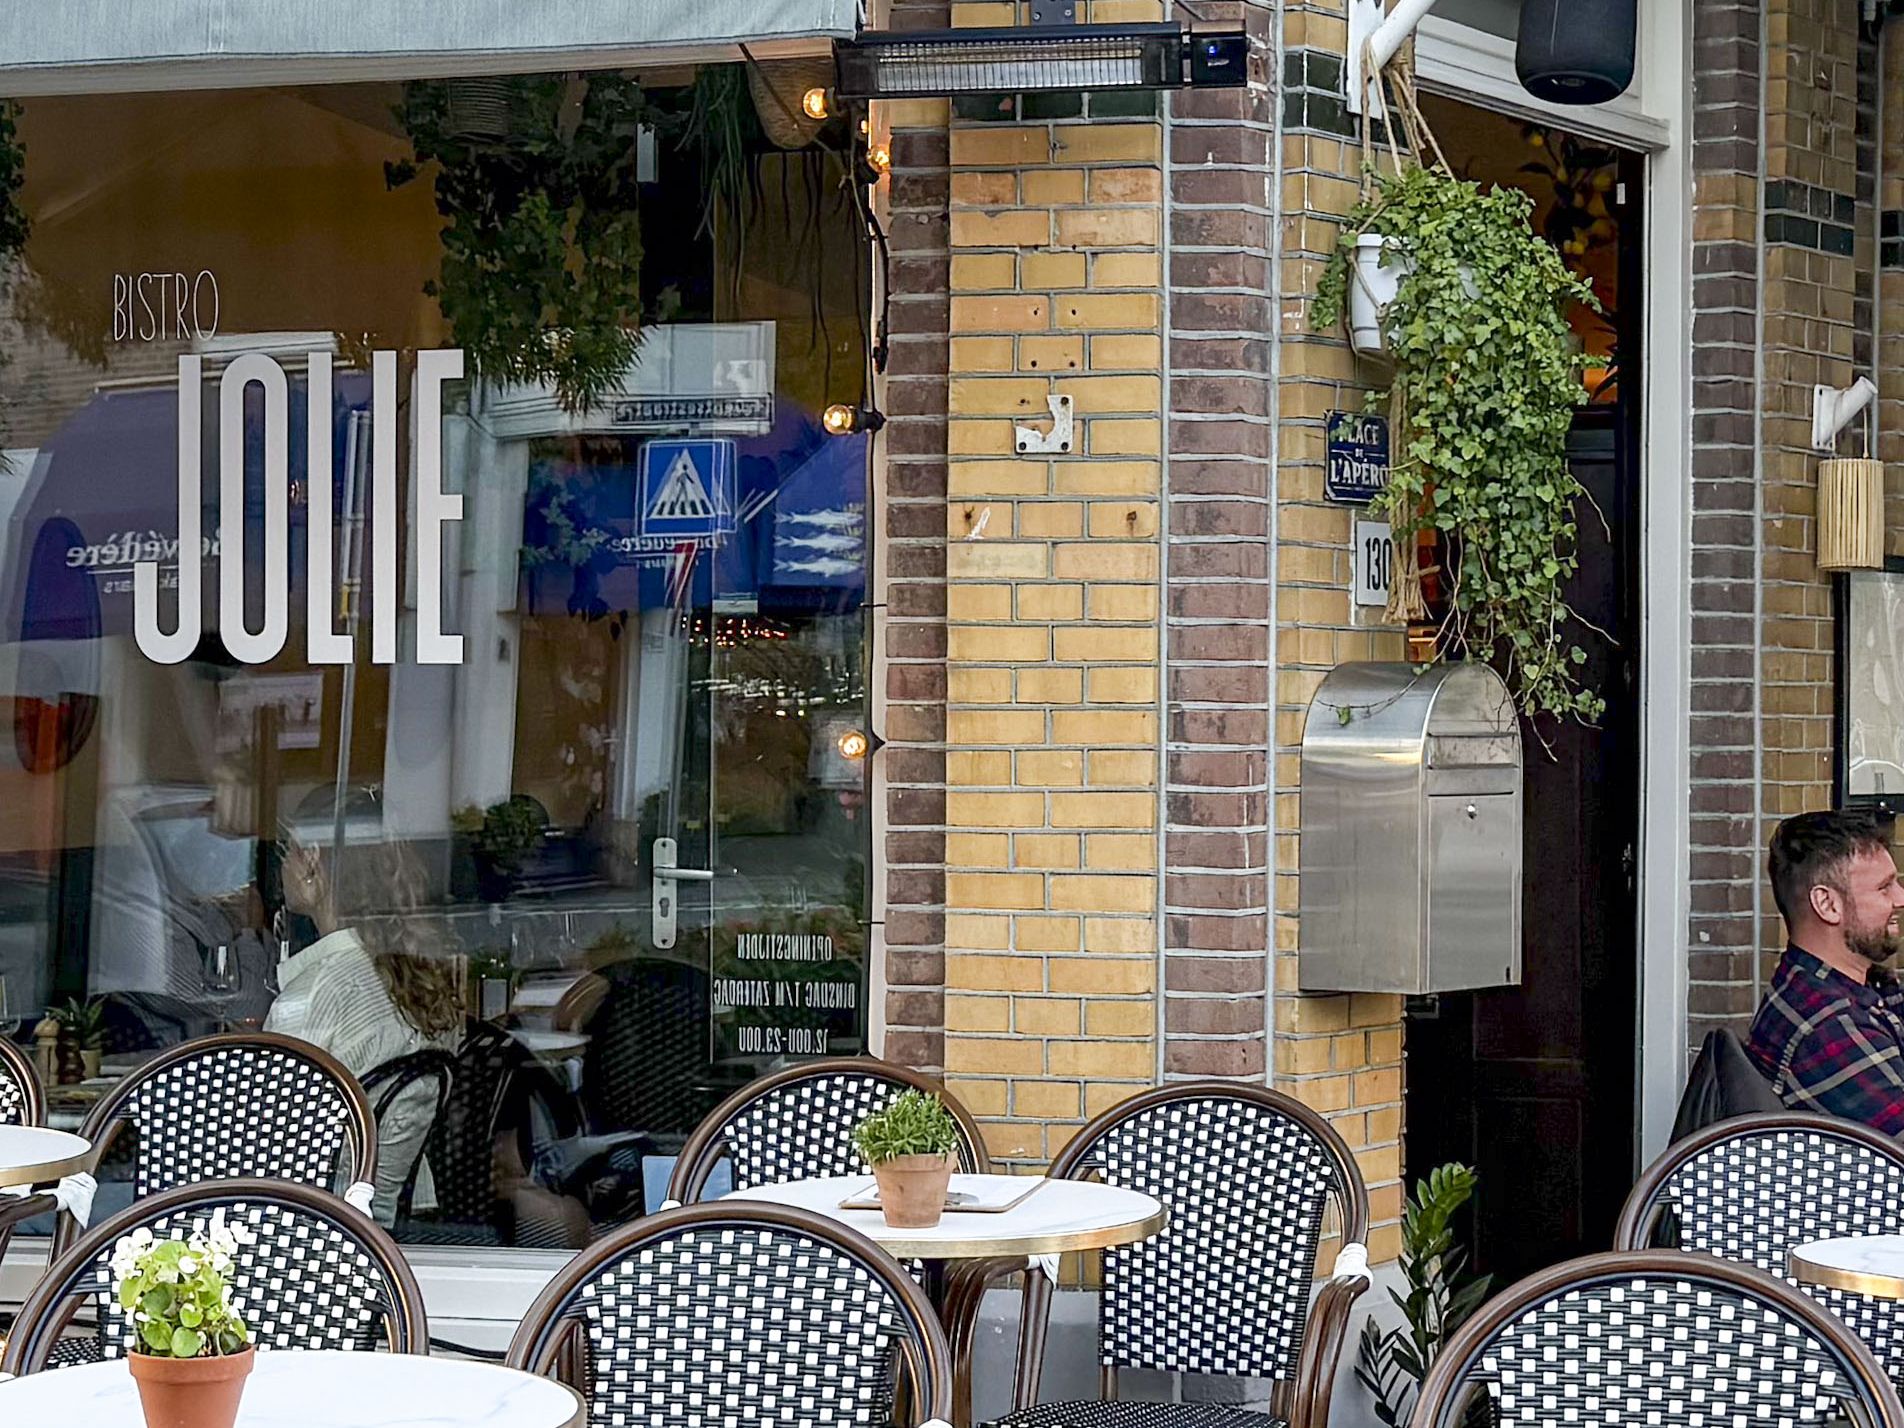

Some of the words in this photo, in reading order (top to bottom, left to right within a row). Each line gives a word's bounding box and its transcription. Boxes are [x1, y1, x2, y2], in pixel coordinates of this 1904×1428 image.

[112, 269, 219, 342] BISTRO
[1339, 420, 1380, 445] LACE
[133, 348, 465, 665] JOLIE
